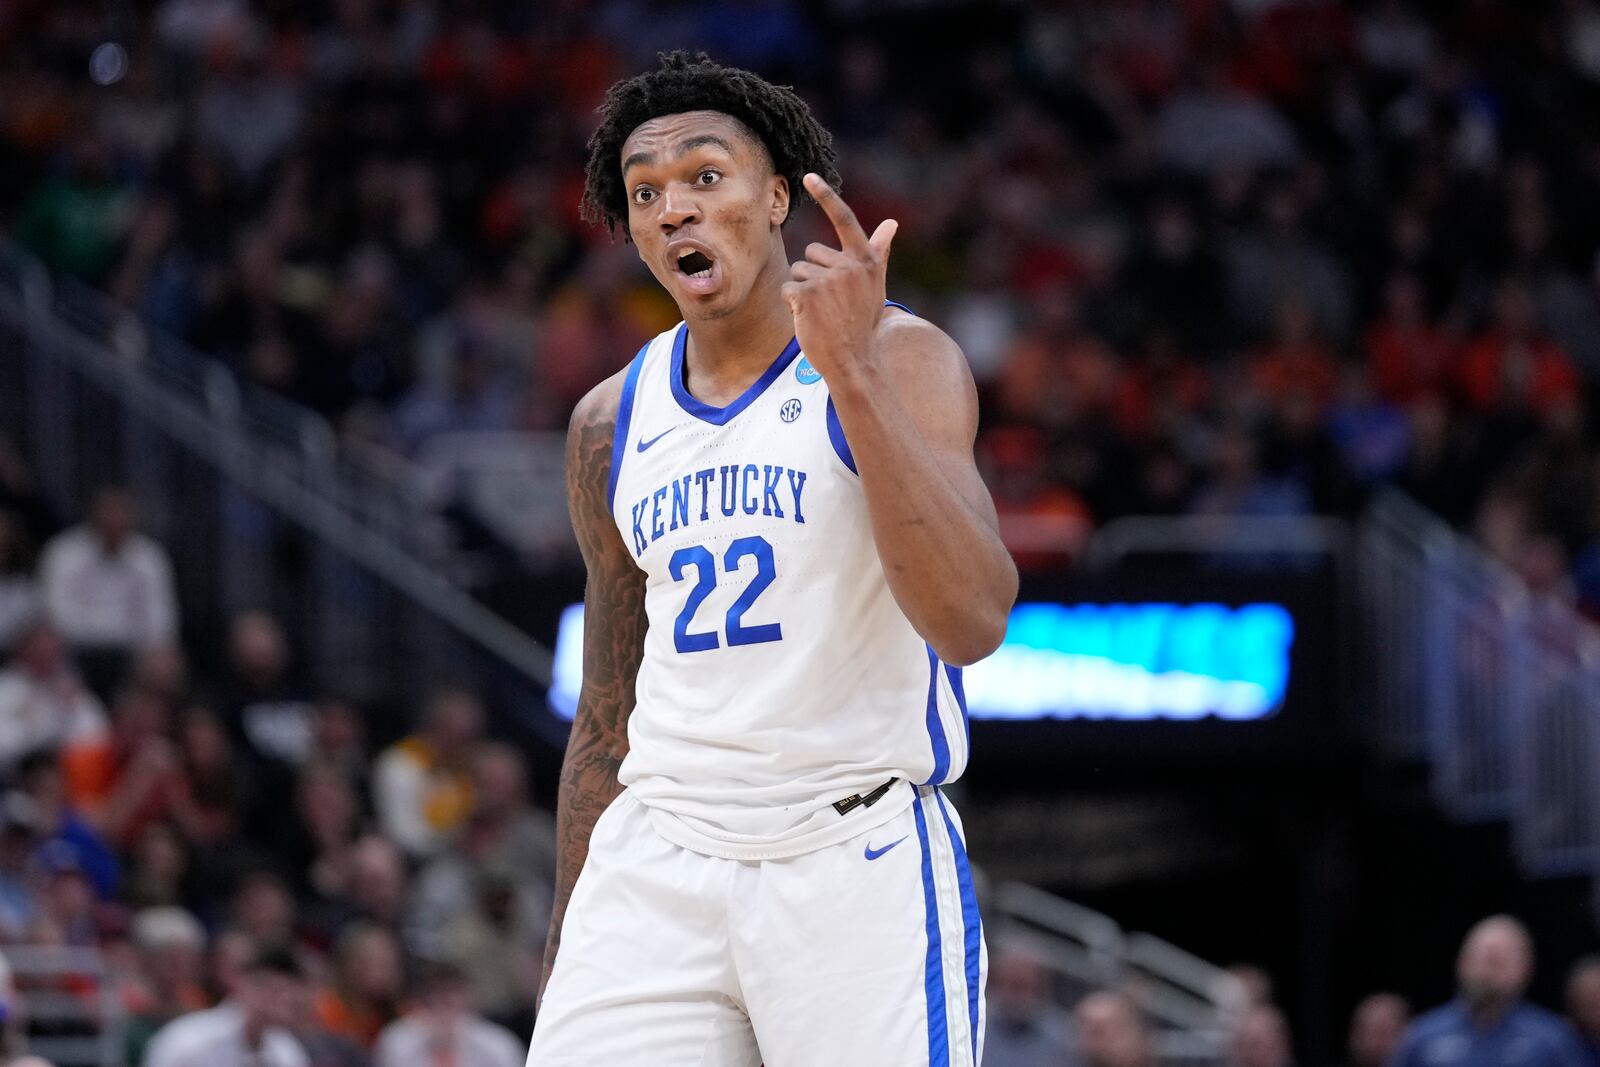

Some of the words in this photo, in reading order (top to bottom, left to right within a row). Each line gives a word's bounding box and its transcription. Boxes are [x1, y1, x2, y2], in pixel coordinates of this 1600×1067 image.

[781, 400, 801, 422] SEC
[632, 464, 807, 558] KENTUCKY
[668, 535, 783, 654] 22
